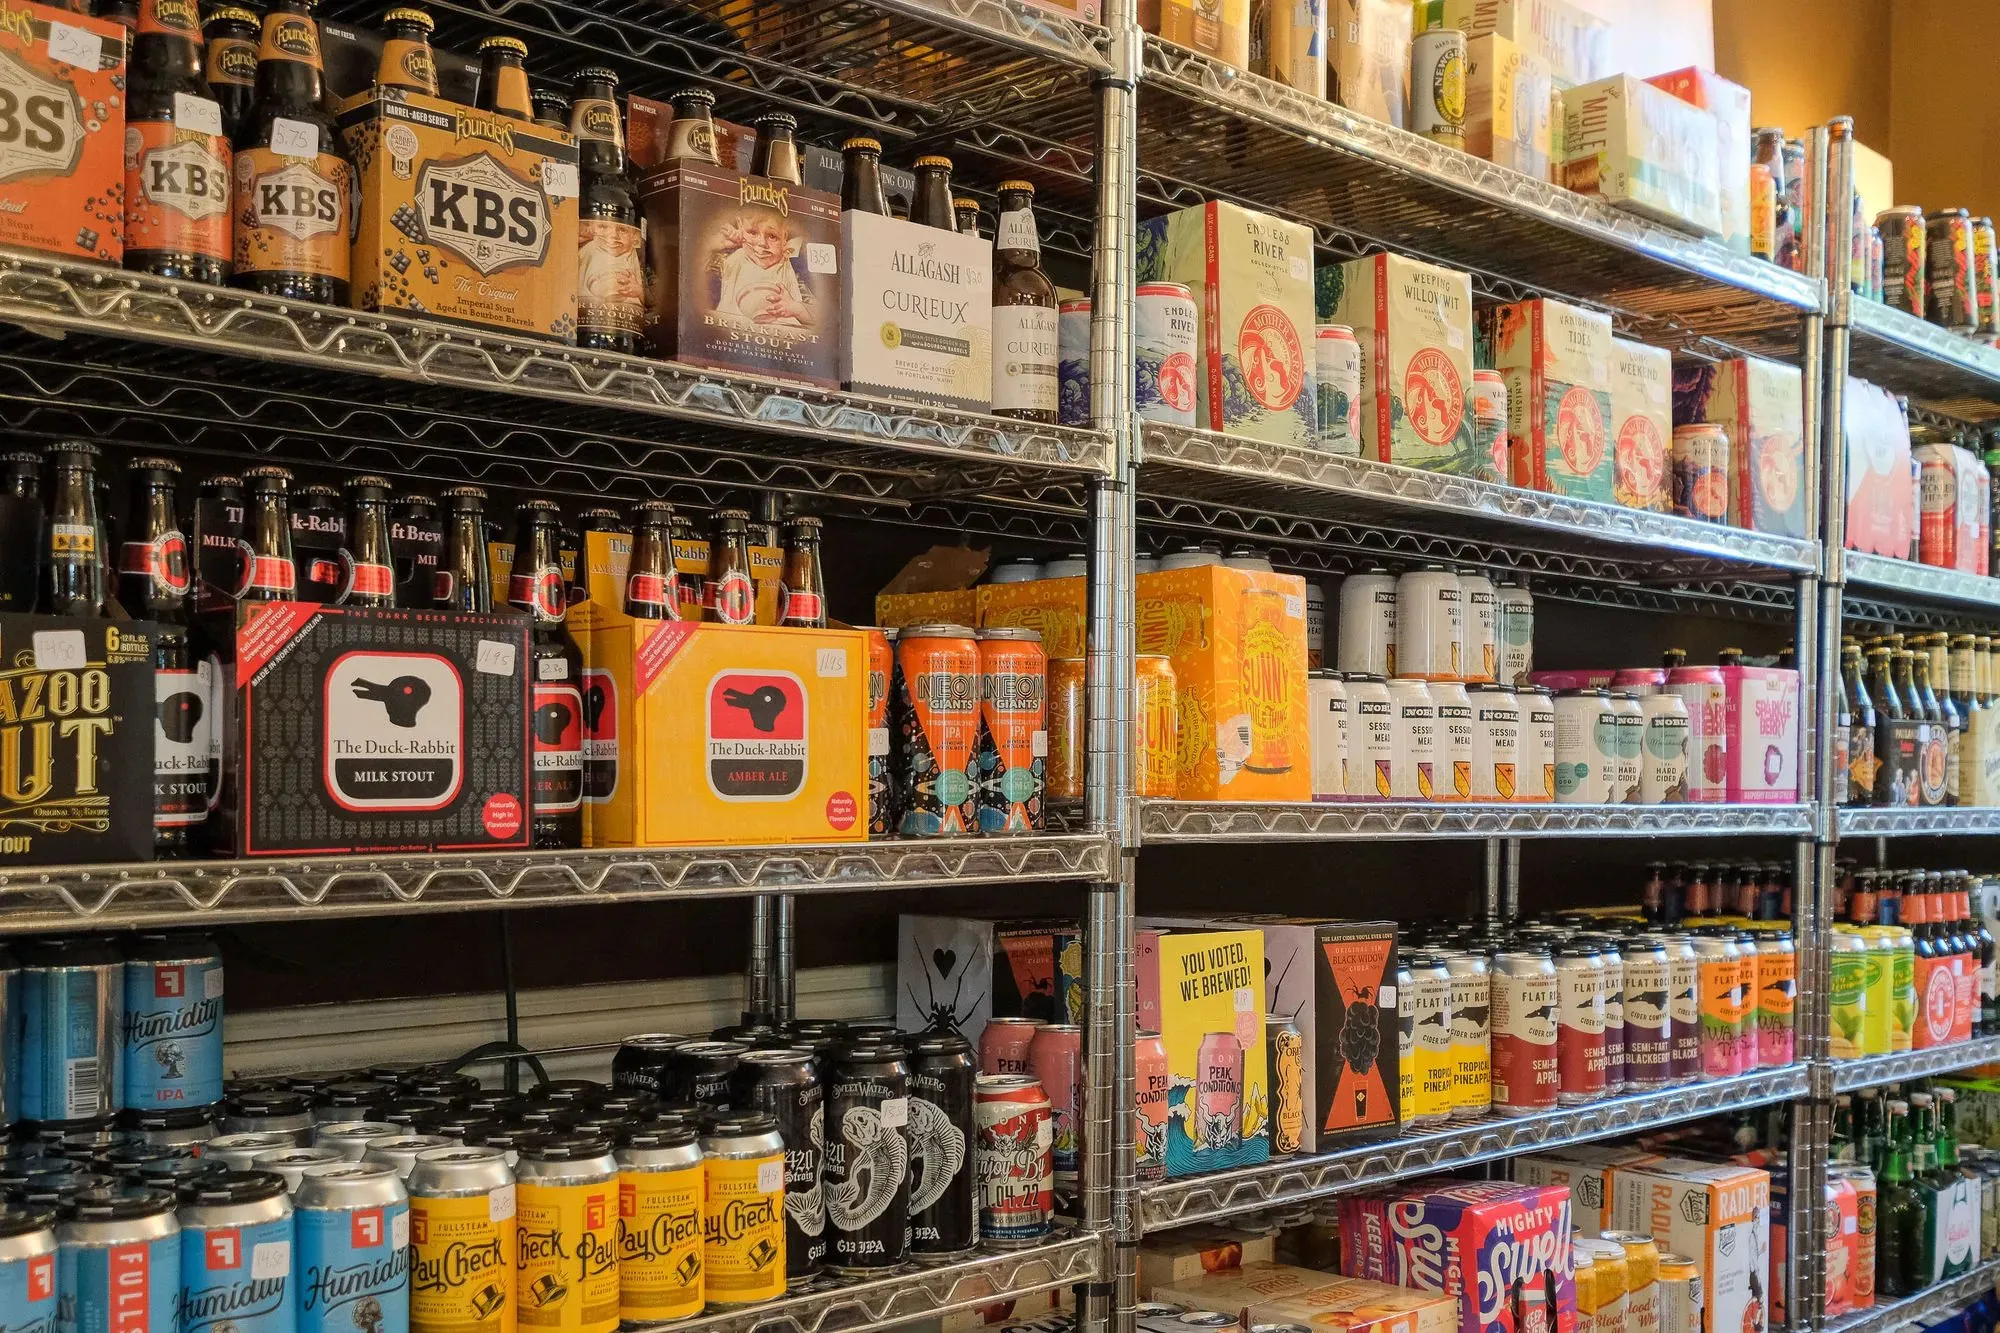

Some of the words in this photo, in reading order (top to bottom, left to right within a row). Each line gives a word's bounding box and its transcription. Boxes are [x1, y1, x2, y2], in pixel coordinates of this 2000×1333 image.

[386, 103, 428, 122] BARREL-AGED
[428, 114, 449, 128] SERIES
[454, 108, 515, 158] Founders
[1581, 97, 1609, 153] MULE
[150, 160, 225, 203] KBS
[260, 184, 336, 222] KBS
[739, 177, 789, 218] Founders
[429, 179, 538, 247] KBS
[1246, 223, 1290, 246] ENDLESS
[1253, 240, 1285, 261] RIVER
[891, 249, 961, 285] ALLAGASH
[453, 276, 472, 293] The
[476, 281, 519, 301] Original
[1412, 272, 1451, 291] WEEPING
[457, 296, 494, 311] Imperial
[495, 302, 516, 315] Stout
[882, 289, 969, 325] CURIEUX
[1443, 293, 1460, 311] WIT
[435, 303, 458, 315] Aged
[459, 306, 468, 316] in
[469, 308, 504, 322] Bourbon
[505, 315, 535, 327] Barrels
[587, 309, 636, 322] STOUT
[703, 314, 820, 344] BREAKFAST
[1559, 314, 1600, 334] VANISHING
[730, 331, 794, 350] STOUT
[924, 342, 947, 351] BOURBON
[1568, 330, 1592, 348] TIDES
[705, 343, 740, 353] COFFEE
[742, 349, 783, 361] OATMEAL
[787, 357, 815, 366] STOUT
[716, 340, 751, 350] DOUBLE
[754, 348, 806, 359] CHOCOLATE
[895, 359, 919, 369] BREWED
[931, 366, 956, 375] BOTTLED
[1619, 362, 1658, 381] WEEKEND
[202, 534, 237, 549] MILK
[243, 607, 275, 637] Traditional
[377, 612, 409, 621] DARK
[416, 614, 447, 623] BEER
[455, 615, 527, 627] SPECIALIST
[239, 623, 271, 654] full-bodied
[269, 604, 289, 626] STOUT
[243, 641, 266, 663] brewed
[265, 629, 278, 642] with
[276, 610, 297, 631] lactose
[105, 626, 120, 652] 6
[121, 642, 150, 653] BOTTLES
[251, 668, 270, 688] MADE
[268, 661, 277, 670] IN
[275, 640, 297, 663] NORTH
[294, 613, 324, 644] CAROLINA
[638, 639, 657, 661] Layered
[645, 657, 664, 679] delicious
[661, 640, 679, 660] AMBER
[676, 630, 686, 642] ALE
[645, 653, 656, 667] malt
[1506, 652, 1525, 661] HARD
[1242, 651, 1289, 704] SUNNY
[929, 699, 974, 711] GIANTS
[996, 699, 1039, 711] GIANTS
[1755, 700, 1791, 719] SPARKLE
[945, 725, 961, 738] IPA
[1010, 725, 1026, 738] IPA
[1489, 728, 1517, 738] SESSION
[1759, 719, 1787, 739] BERRY
[333, 739, 362, 755] The
[364, 739, 456, 755] Duck-Rabbit
[709, 742, 732, 756] The
[734, 742, 805, 756] Duck-Rabbit
[1495, 739, 1515, 748] MEAD
[354, 770, 389, 783] MILK
[391, 770, 435, 783] STOUT
[727, 770, 764, 782] AMBER
[766, 770, 789, 782] ALE
[1618, 766, 1637, 775] HARD
[1618, 774, 1637, 782] CIDER
[1656, 766, 1677, 775] HARD
[1656, 774, 1676, 783] CIDER
[489, 801, 516, 812] Naturally
[831, 797, 853, 807] Naturally
[491, 811, 505, 821] High
[505, 811, 514, 820] in
[829, 814, 855, 823] Flavonoids
[833, 806, 844, 815] High
[486, 820, 519, 829] Flavonoids
[1335, 945, 1368, 954] ORIGINAL
[1181, 950, 1206, 976] YOU
[1206, 942, 1248, 971] VOTED,
[1332, 954, 1357, 965] BLACK
[1358, 953, 1384, 963] WIDOW
[1672, 974, 1692, 985] FLAT
[1714, 975, 1736, 985] FLAT
[1760, 967, 1782, 977] FLAT
[1179, 980, 1201, 1002] WE
[1202, 966, 1252, 999] BREWED!
[1574, 983, 1596, 993] FLAT
[1625, 979, 1649, 987] FLAT
[1416, 998, 1440, 1008] FLAT
[1522, 991, 1546, 1002] FLAT
[1580, 1016, 1595, 1027] CIDER
[1630, 1010, 1647, 1021] CIDER
[124, 1000, 219, 1051] Humidity
[1528, 1027, 1545, 1037] CIDER
[1422, 1034, 1438, 1045] CIDER
[1631, 1041, 1669, 1052] SEMI-TART
[1209, 1065, 1232, 1081] PEAK
[156, 1088, 185, 1101] IPA
[1199, 1078, 1241, 1095] CONDITIONS
[1015, 1145, 1046, 1182] By
[646, 1193, 691, 1205] FULLSTEAM
[1719, 1181, 1769, 1221] RADLER
[438, 1221, 489, 1233] FULLSTEAM
[723, 1199, 778, 1241] Check
[1495, 1206, 1554, 1237] MIGHTY
[652, 1210, 703, 1257] Check
[914, 1226, 941, 1240] IPA
[1362, 1212, 1383, 1255] KEEP
[836, 1239, 856, 1254] G13
[858, 1239, 885, 1254] IPA
[443, 1237, 507, 1288] Check
[1368, 1255, 1383, 1278] IT
[1477, 1199, 1576, 1325] Swell
